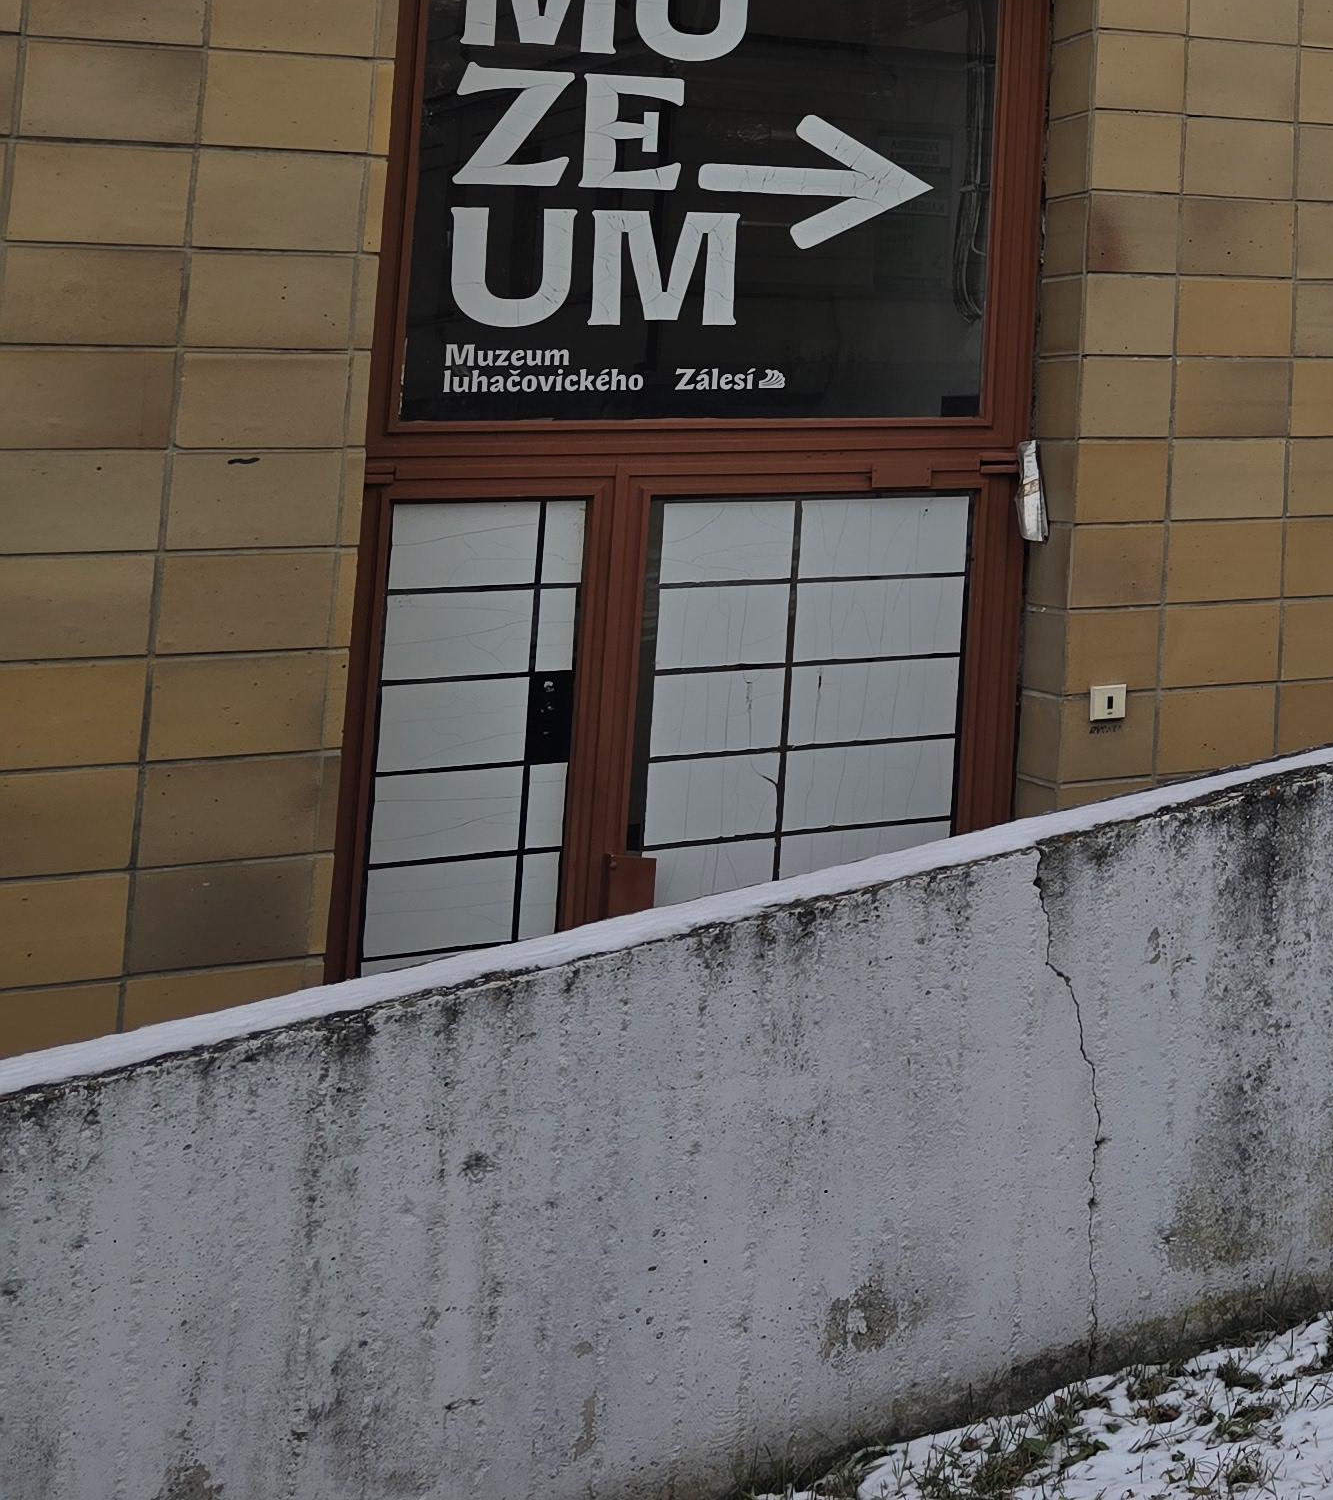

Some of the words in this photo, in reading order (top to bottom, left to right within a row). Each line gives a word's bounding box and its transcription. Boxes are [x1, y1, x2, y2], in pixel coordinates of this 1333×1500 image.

[451, 61, 686, 190] ZE
[450, 206, 741, 328] UM
[442, 369, 644, 394] luhačovického
[675, 367, 757, 392] Zálesí
[444, 344, 570, 367] Muzeum
